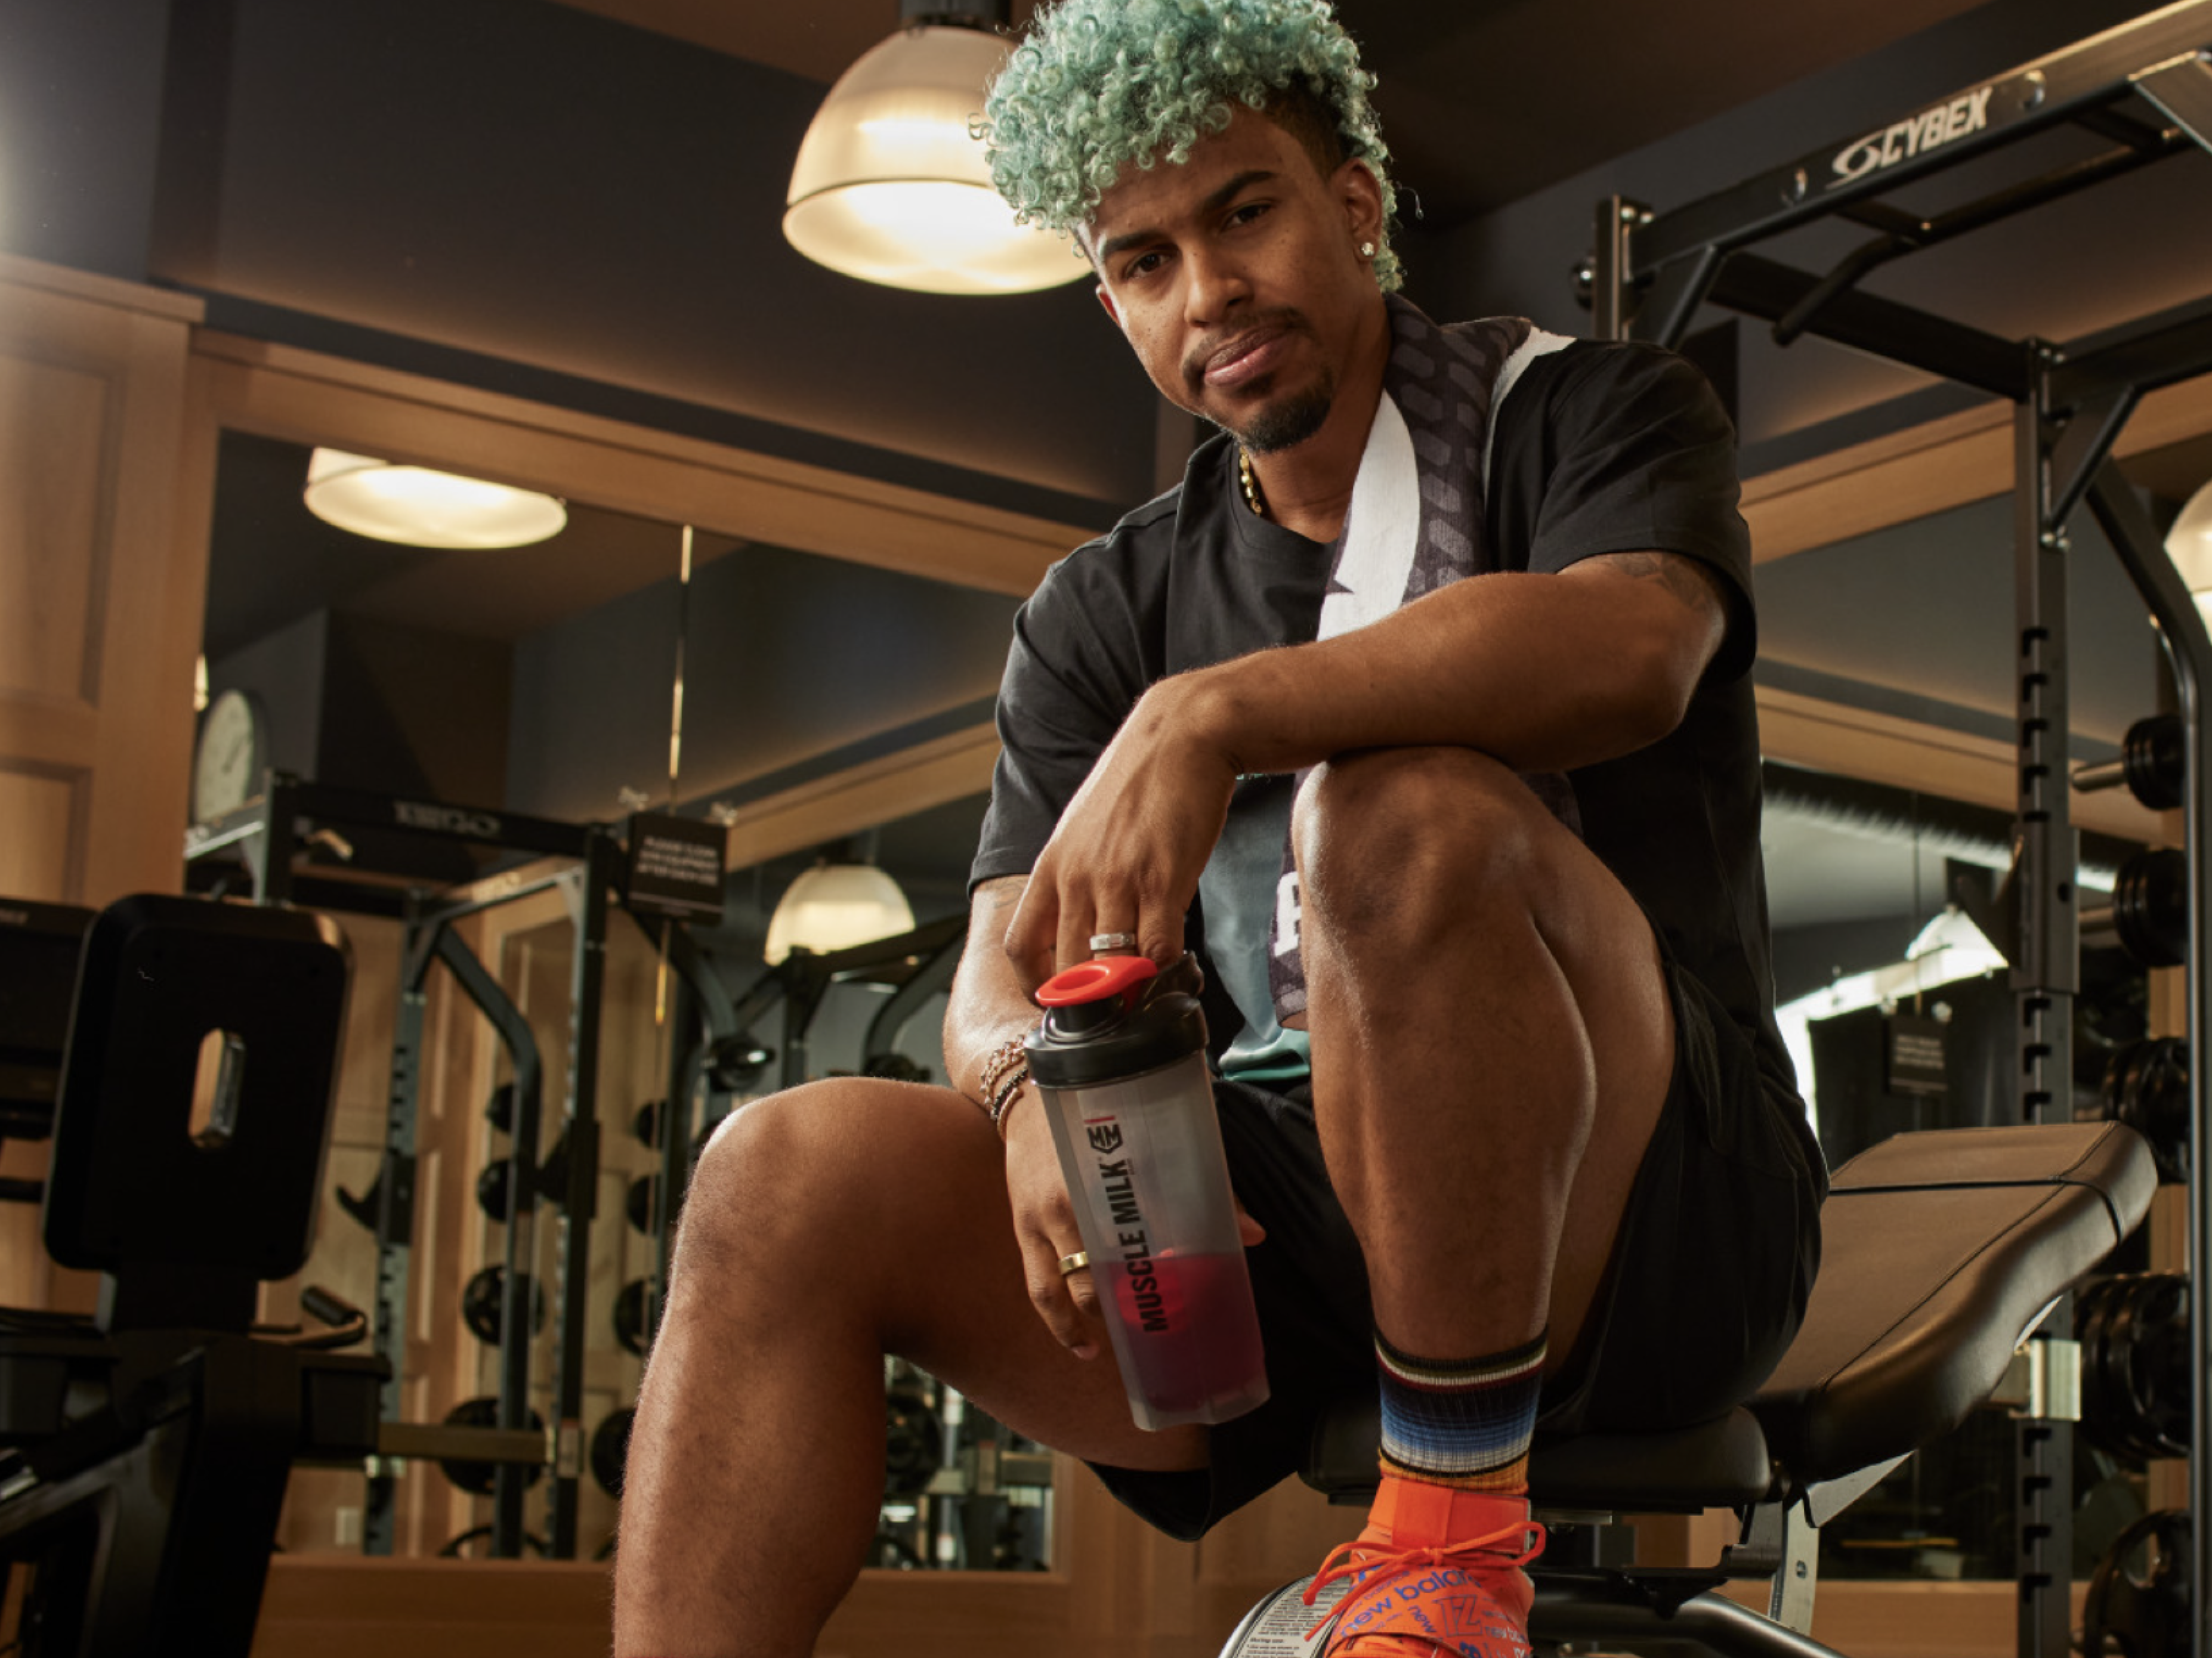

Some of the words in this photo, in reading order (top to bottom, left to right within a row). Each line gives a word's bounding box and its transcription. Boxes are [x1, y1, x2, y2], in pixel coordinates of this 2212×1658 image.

[1880, 86, 1993, 168] CYBEX
[1098, 1159, 1141, 1224] MILK
[1119, 1229, 1168, 1332] MUSCLE
[1340, 1596, 1392, 1638] new
